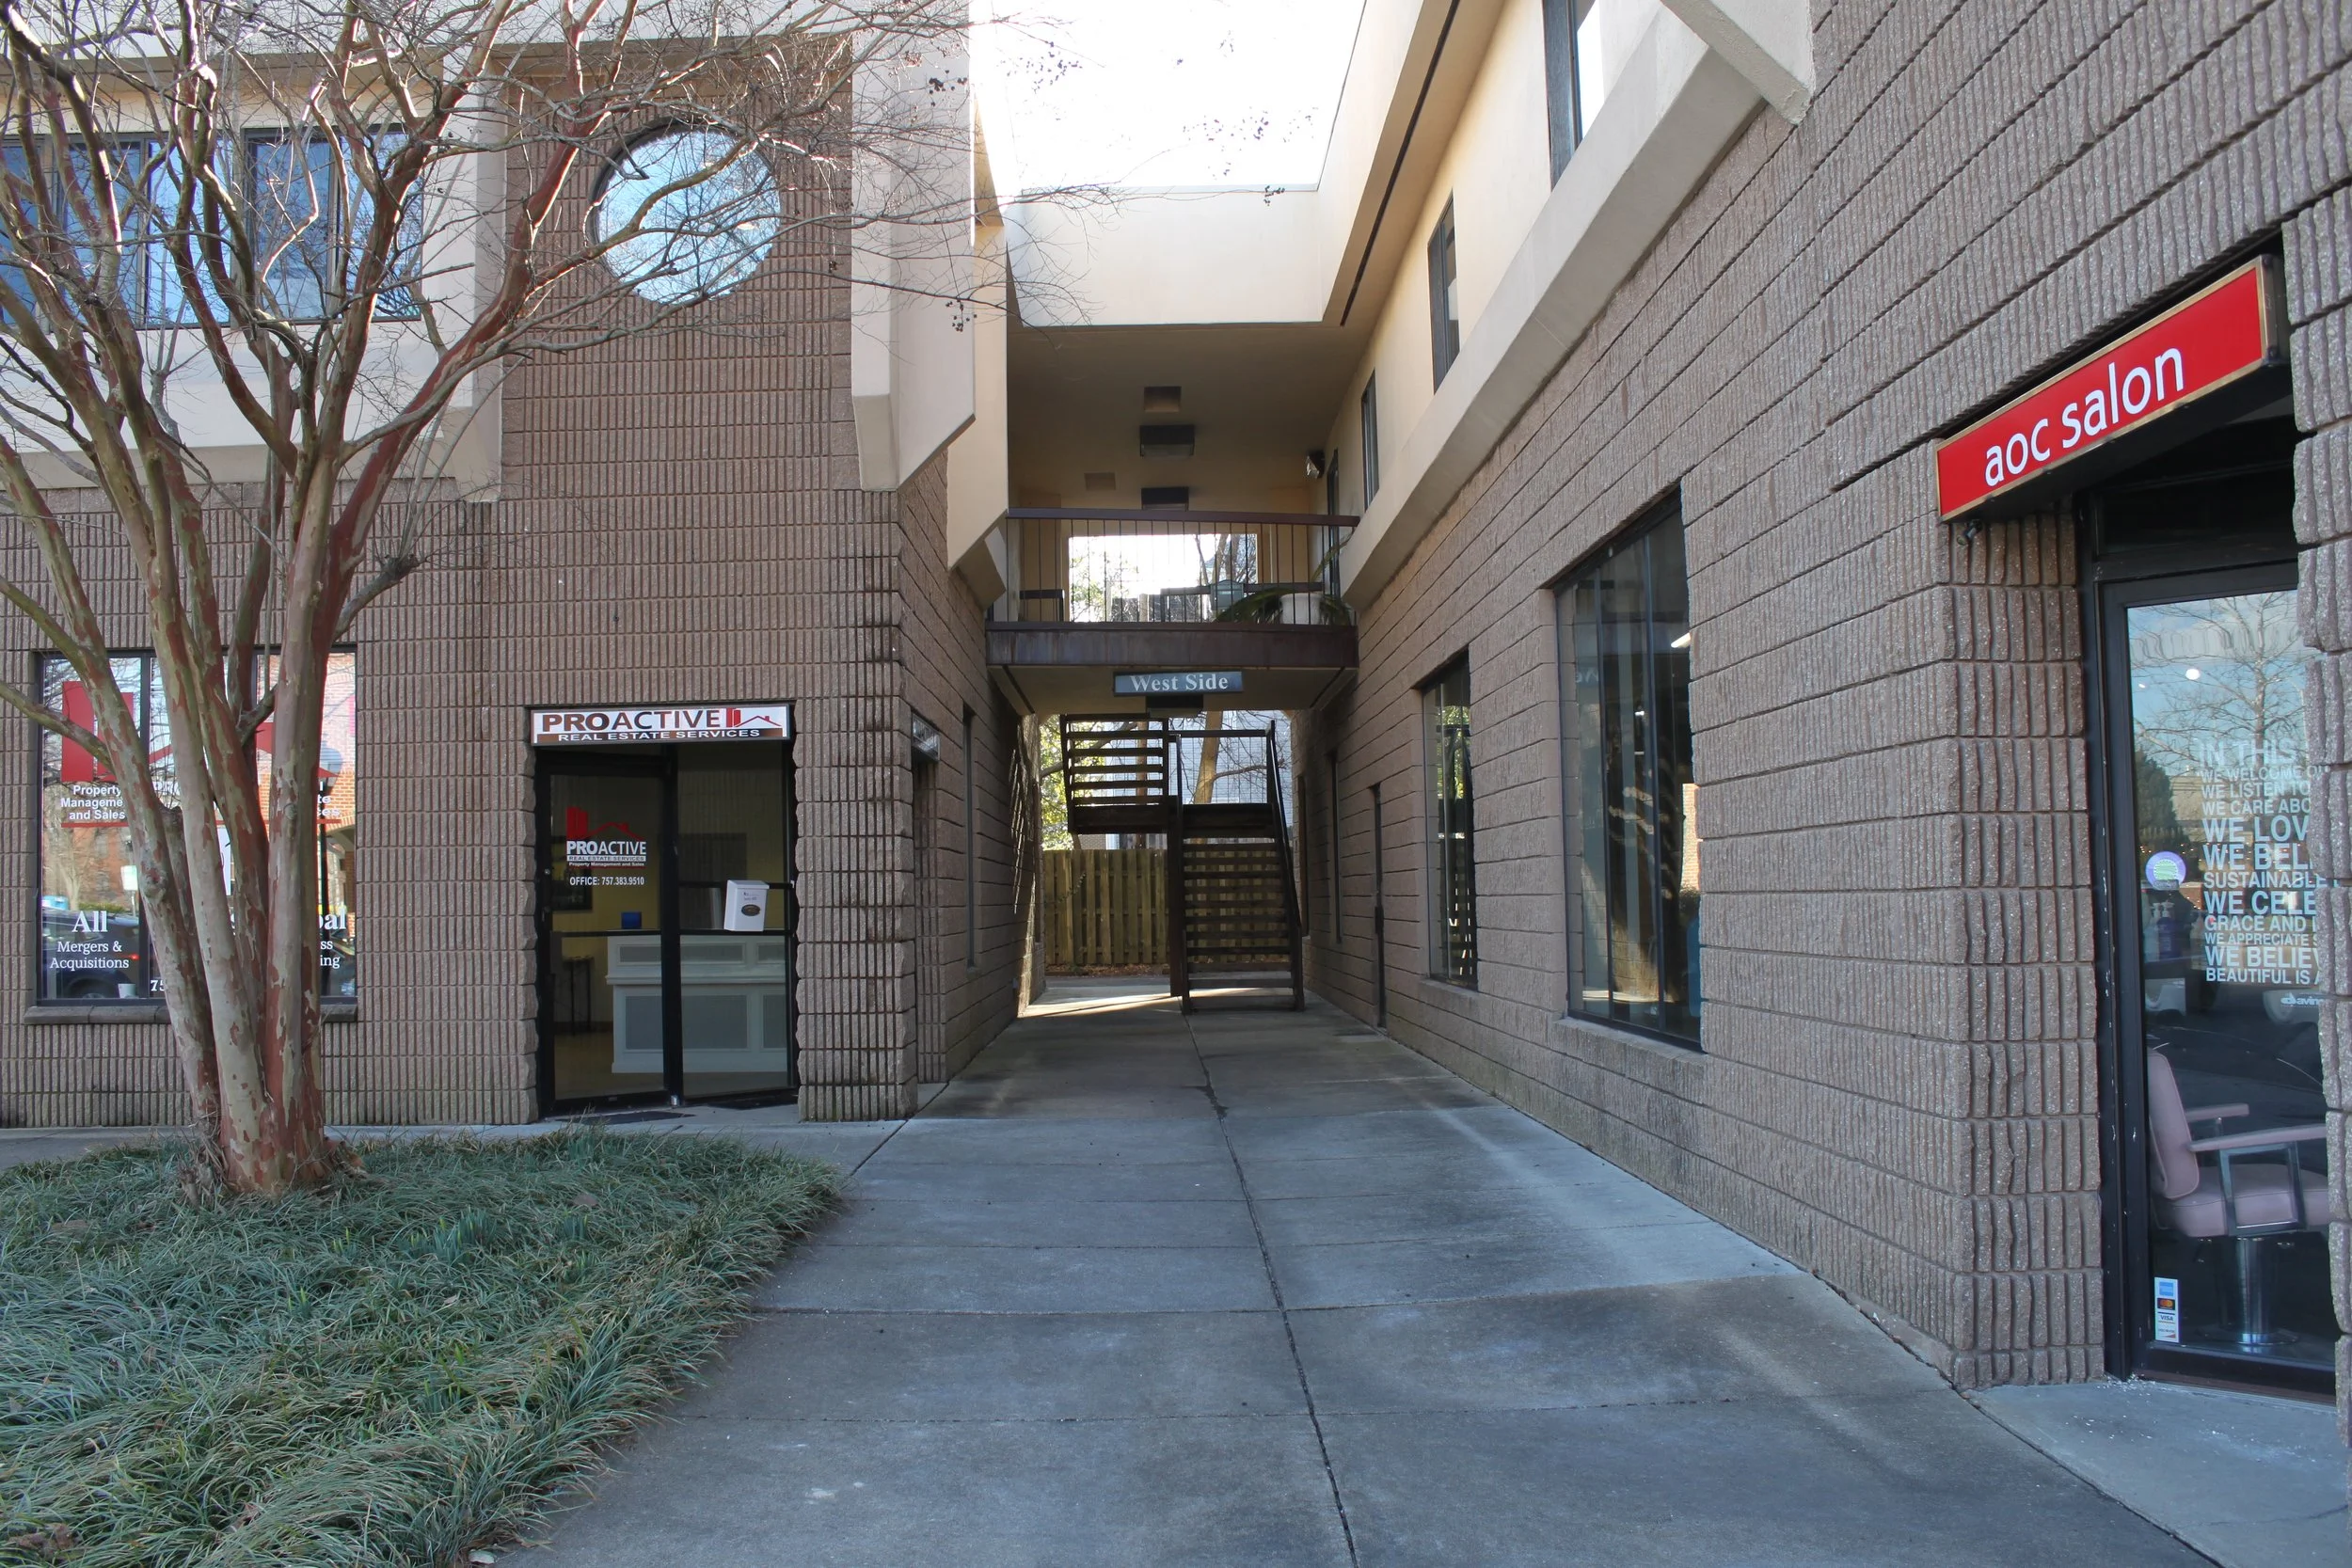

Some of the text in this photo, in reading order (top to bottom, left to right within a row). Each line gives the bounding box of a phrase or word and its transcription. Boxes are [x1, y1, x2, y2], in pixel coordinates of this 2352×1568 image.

[1985, 347, 2185, 486] aoc salon
[1130, 673, 1229, 691] West Side
[542, 709, 721, 732] PROACTIVE
[558, 729, 760, 741] REAL ESTATE SERVICES
[2202, 769, 2222, 784] WE
[2227, 767, 2303, 783] WELCOME
[73, 784, 122, 798] Property
[2202, 784, 2225, 799] WE
[2231, 782, 2285, 798] LISTEN
[60, 798, 123, 809] Manageme
[2202, 798, 2312, 816] WE CARE ABO
[69, 809, 126, 820] and Sales
[2202, 815, 2310, 843] WE LOV
[566, 840, 647, 855] PROACTIVE
[2202, 844, 2246, 870] WE
[569, 877, 644, 886] OFFICE: 757.383.9510
[2203, 872, 2328, 889] SUSTAINABLE
[2203, 891, 2245, 914] WE
[72, 911, 108, 933] All
[2205, 915, 2265, 931] GRACE
[2269, 916, 2307, 932] AND
[2205, 932, 2225, 944] WE
[2228, 933, 2310, 946] APPRECIATE
[57, 941, 122, 955] Mergers &
[50, 958, 130, 971] Acquisitions
[2205, 945, 2321, 969] WE BELIE
[2206, 968, 2292, 984] BEAUTIFUL
[2296, 970, 2311, 985] IS
